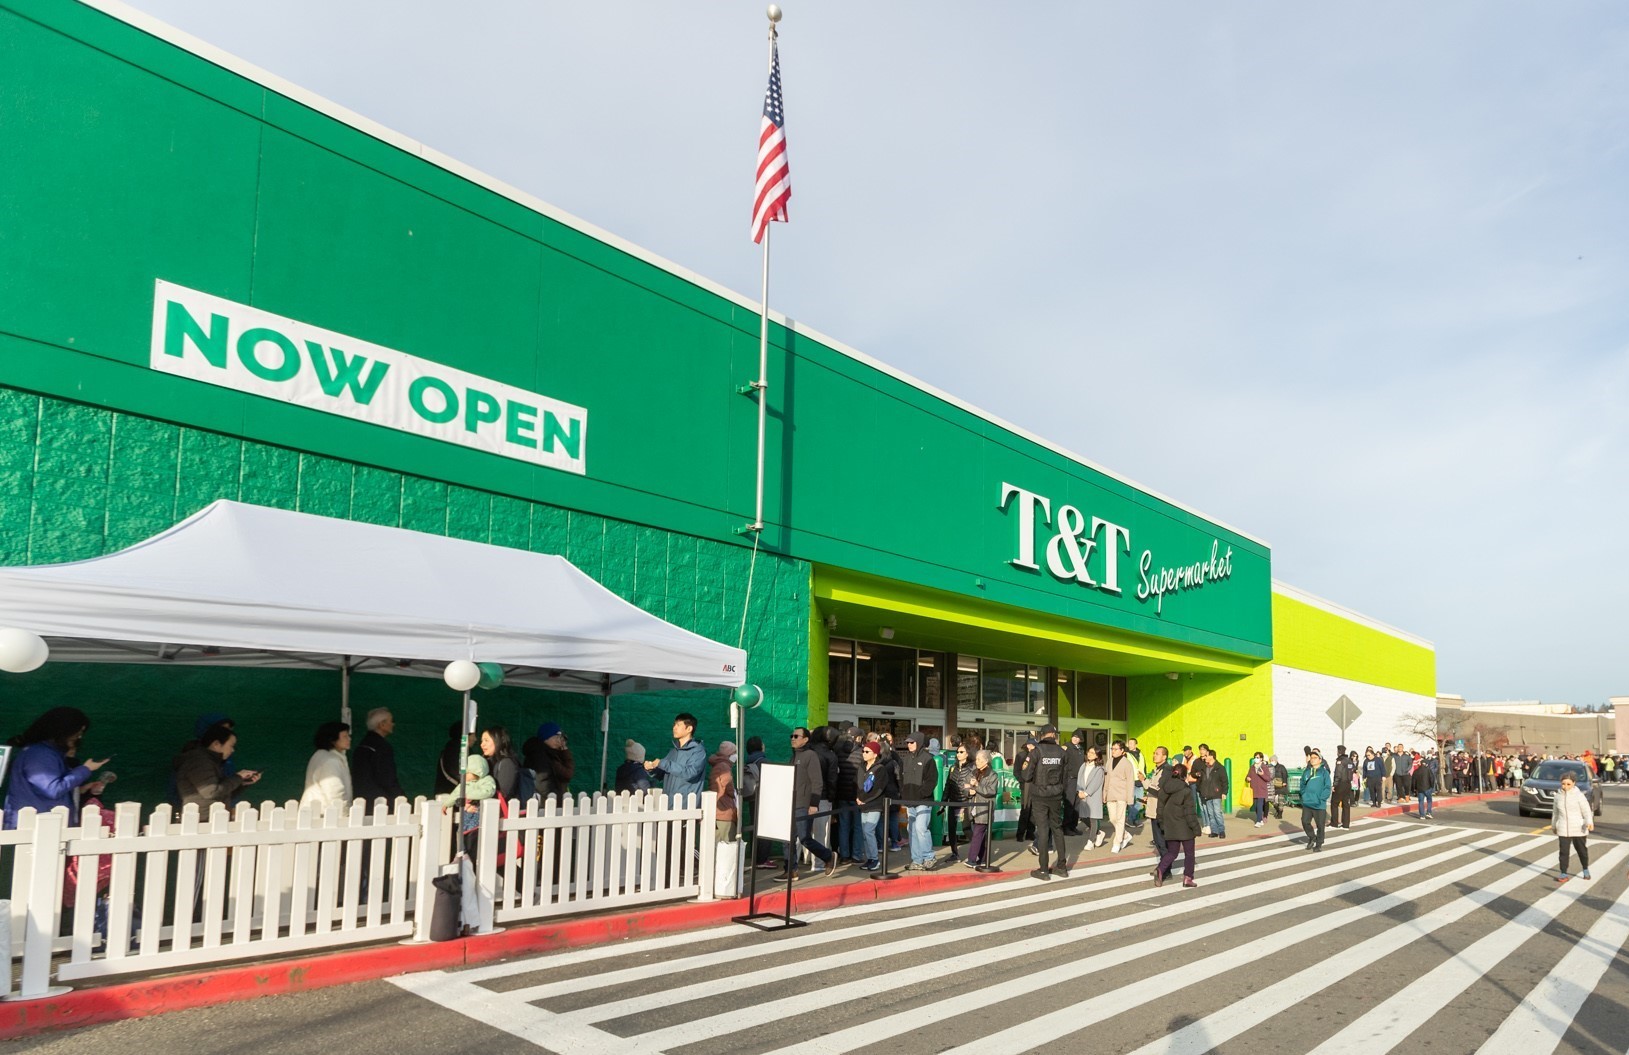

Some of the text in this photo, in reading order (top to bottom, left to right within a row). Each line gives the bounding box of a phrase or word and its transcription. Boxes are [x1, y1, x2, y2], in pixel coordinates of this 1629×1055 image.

[164, 300, 581, 460] NOW OPEN
[1000, 481, 1233, 614] T&T Supermarket
[722, 664, 736, 673] ABC
[1042, 757, 1061, 765] SECURITY
